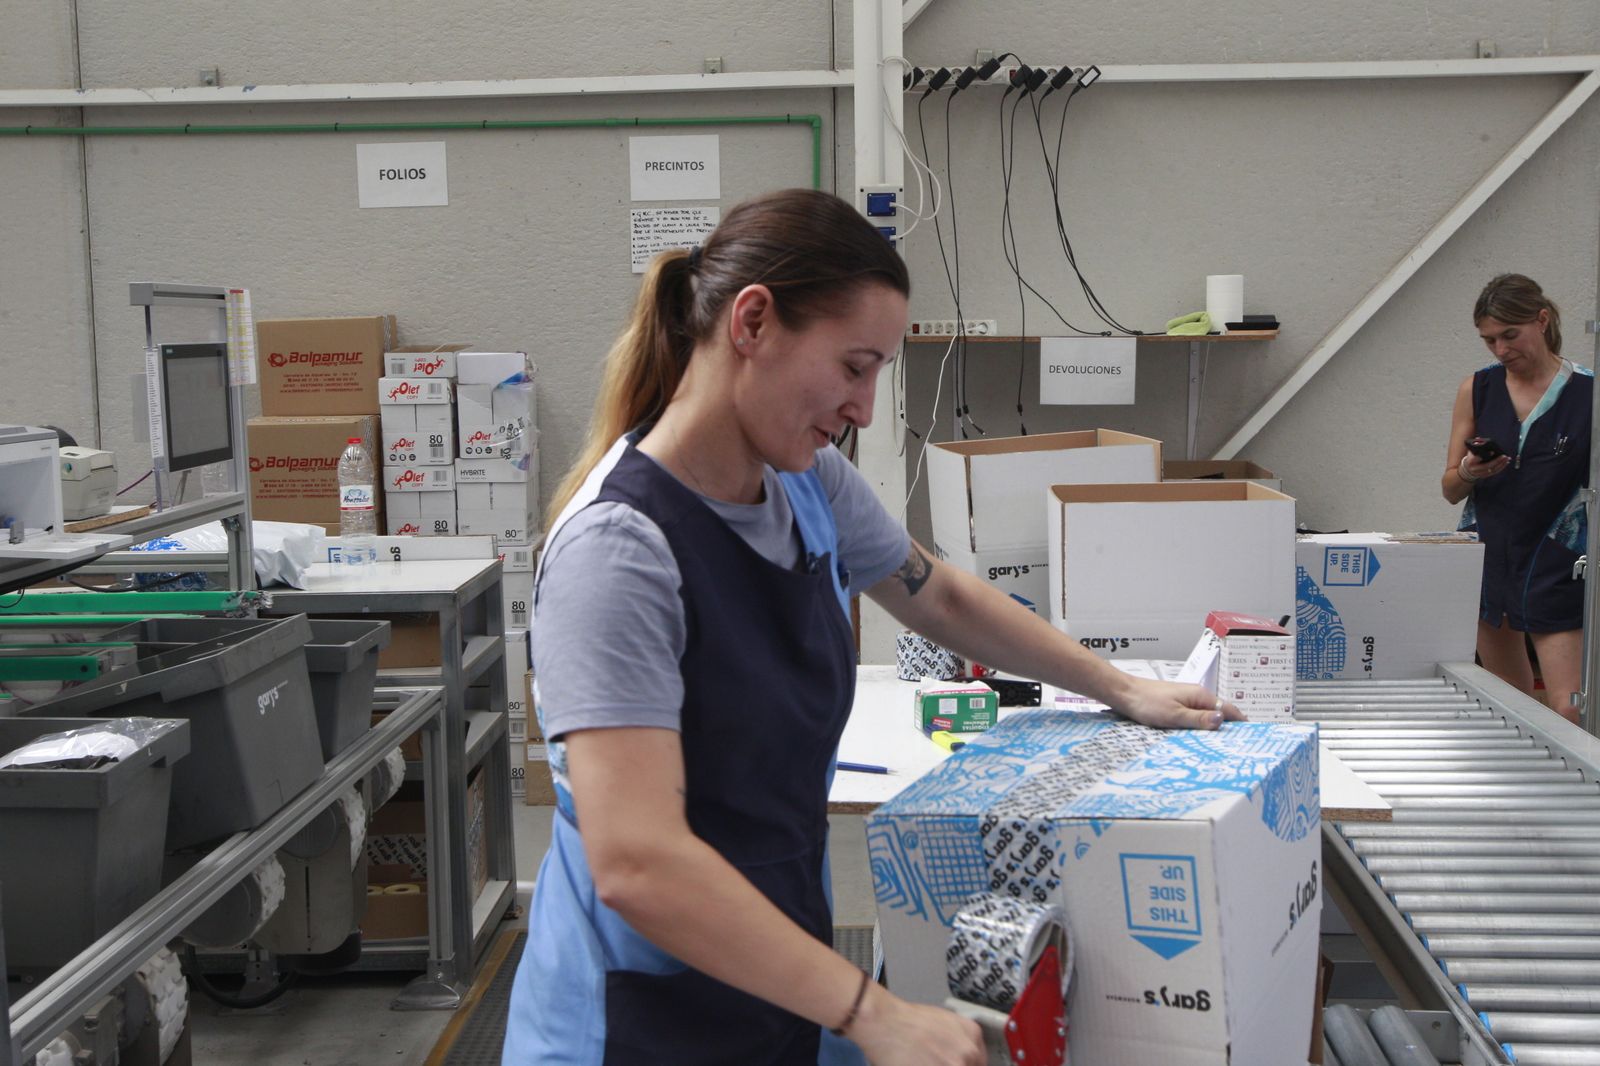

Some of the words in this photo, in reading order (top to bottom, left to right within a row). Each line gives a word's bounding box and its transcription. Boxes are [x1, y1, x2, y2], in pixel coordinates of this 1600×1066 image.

[645, 161, 705, 171] PRECINTOS
[379, 168, 426, 180] FOLIOS
[289, 351, 363, 367] Bolpamur
[413, 362, 435, 375] Olef
[1048, 364, 1122, 375] DEVOLUCIONES
[399, 382, 420, 394] Olef
[399, 438, 415, 447] Olef
[429, 434, 443, 444] 80
[266, 456, 340, 472] Bolpamur
[404, 470, 425, 482] Olef
[434, 520, 448, 530] 80
[505, 529, 517, 538] 80
[1330, 553, 1338, 566] UP.
[1341, 553, 1350, 573] SIDE
[1352, 553, 1361, 574] THIS
[988, 564, 1030, 580] gary's
[511, 600, 525, 610] 80
[1080, 637, 1130, 652] gary's
[1362, 636, 1374, 672] gary's
[258, 686, 279, 715] gary's
[508, 701, 520, 710] 80
[511, 767, 525, 777] 80
[1006, 830, 1040, 873] gary's
[1020, 844, 1054, 887] gary's
[1159, 865, 1185, 881] UP.
[1149, 886, 1187, 901] SIDE
[1288, 859, 1318, 931] gary's
[1149, 906, 1188, 923] THIS
[1143, 985, 1212, 1012] gary's
